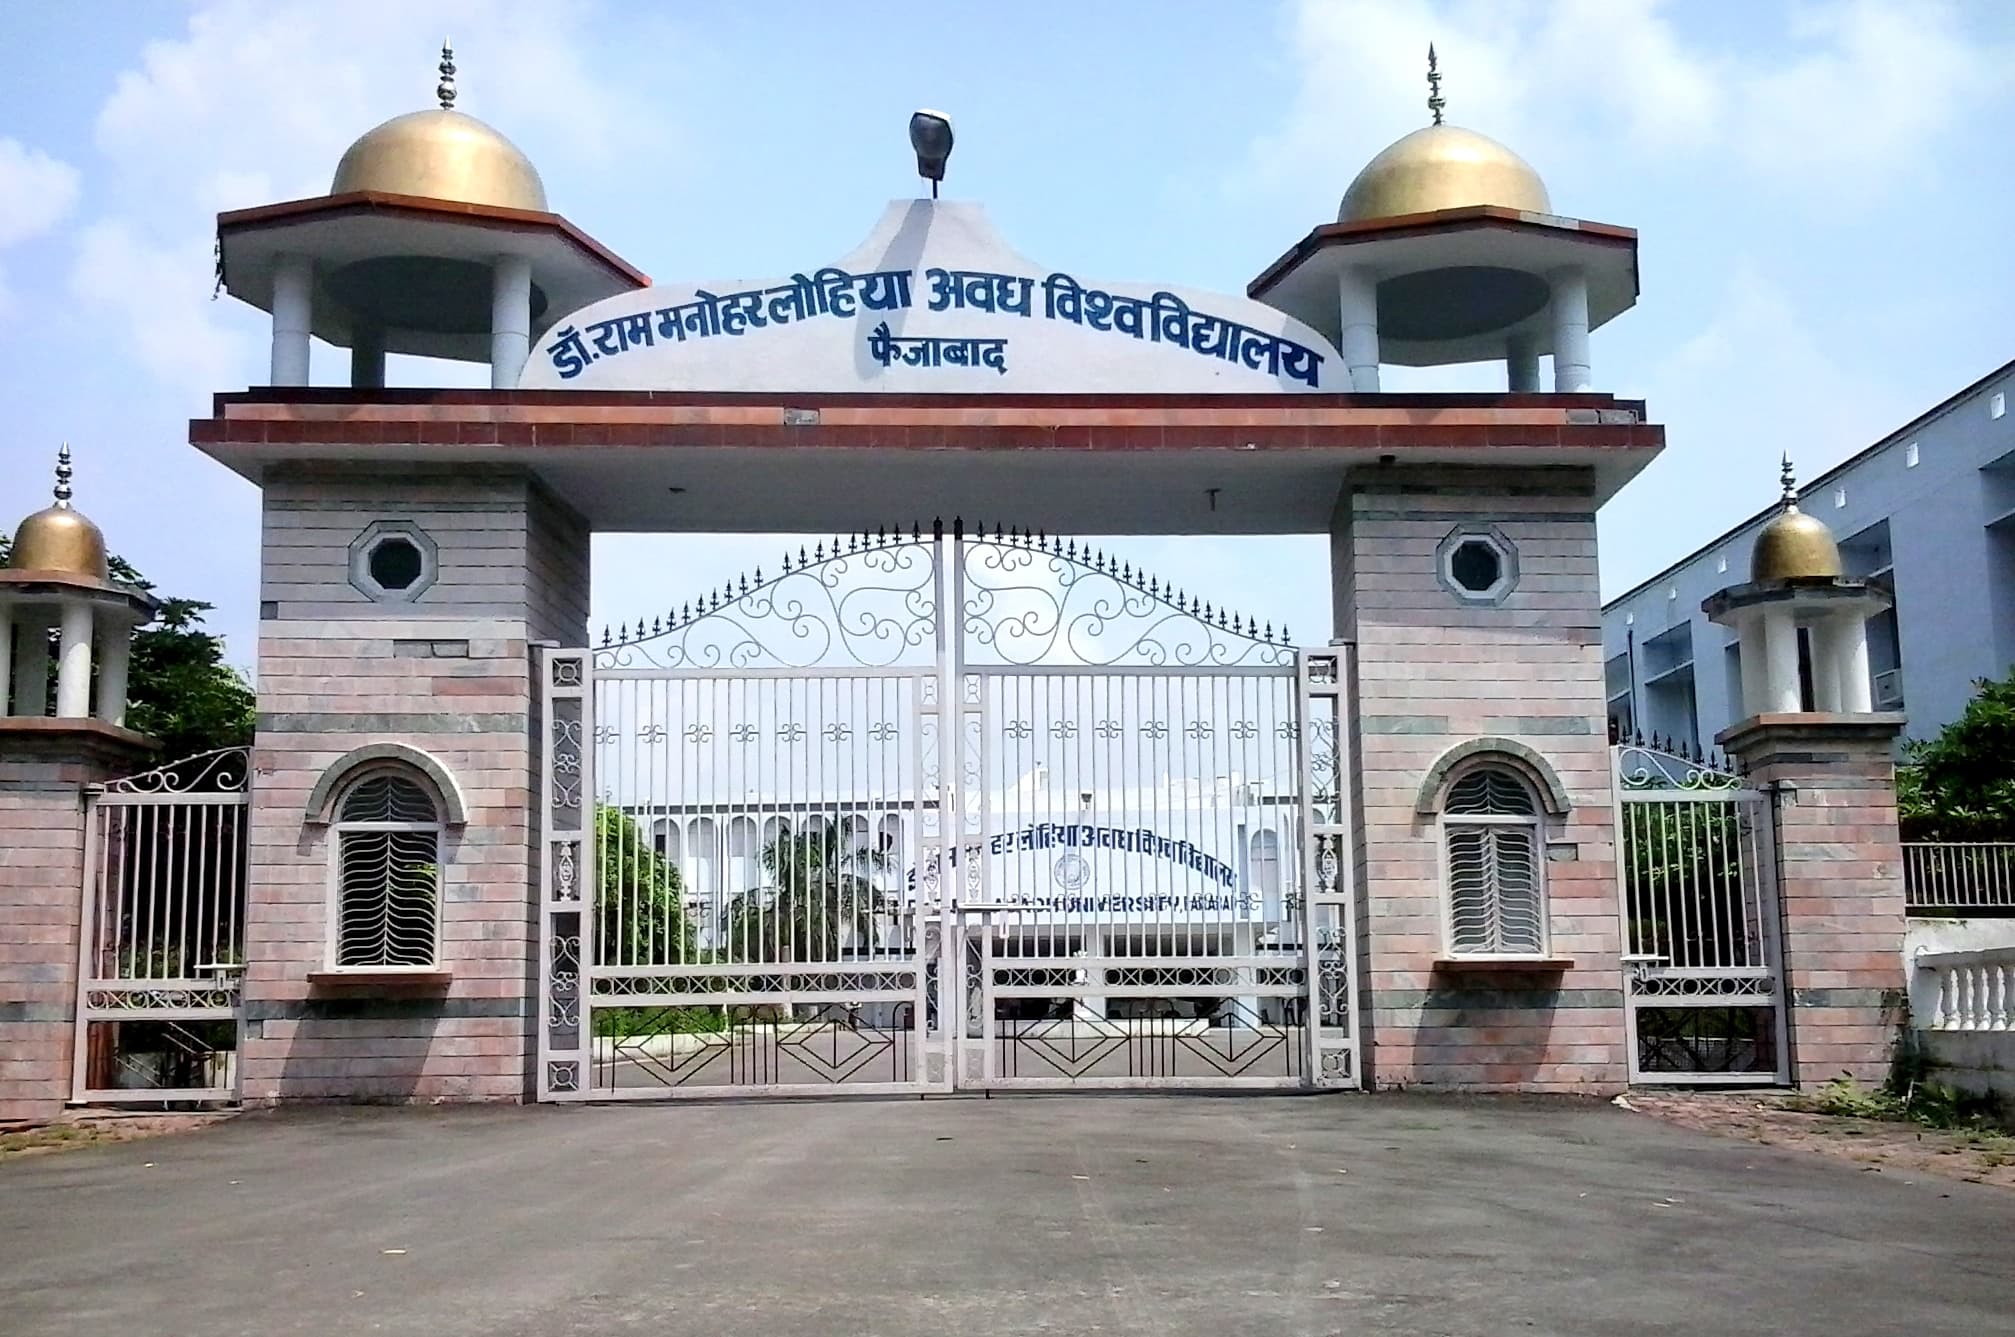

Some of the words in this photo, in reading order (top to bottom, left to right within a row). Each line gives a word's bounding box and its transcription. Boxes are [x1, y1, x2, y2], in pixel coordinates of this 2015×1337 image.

[867, 320, 1009, 376] फैजाबाद
[925, 268, 1035, 318] अवध
[1041, 272, 1325, 388] विश्वविद्यालय
